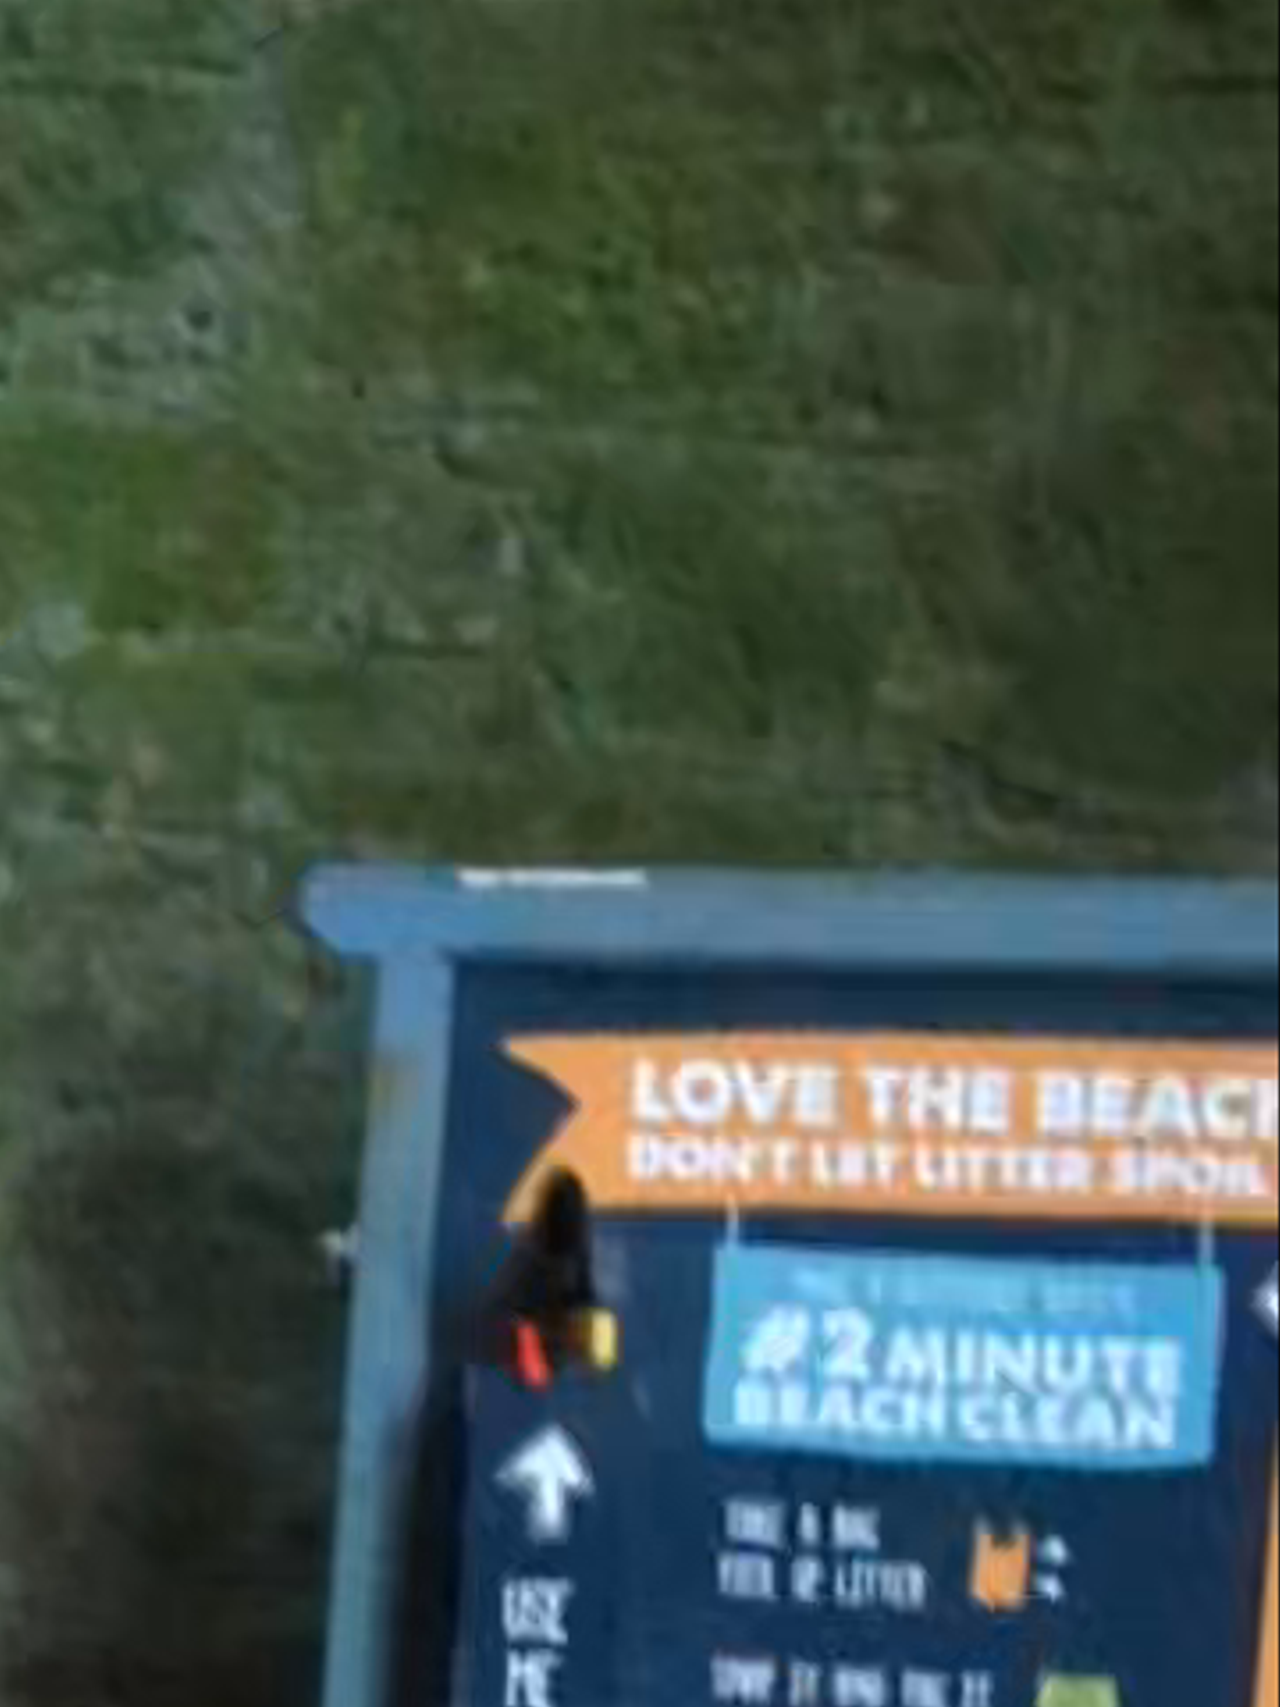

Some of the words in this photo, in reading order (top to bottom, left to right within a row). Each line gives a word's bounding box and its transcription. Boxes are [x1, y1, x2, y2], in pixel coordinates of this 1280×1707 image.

[631, 1059, 838, 1129] LOVE
[866, 1065, 1014, 1135] THE
[809, 1141, 898, 1188] LET
[912, 1145, 1092, 1192] LITTER
[884, 1326, 1182, 1395] MINUTE
[733, 1378, 946, 1435] BEACH
[957, 1389, 1177, 1450] CLEAN
[502, 1577, 574, 1644] USE
